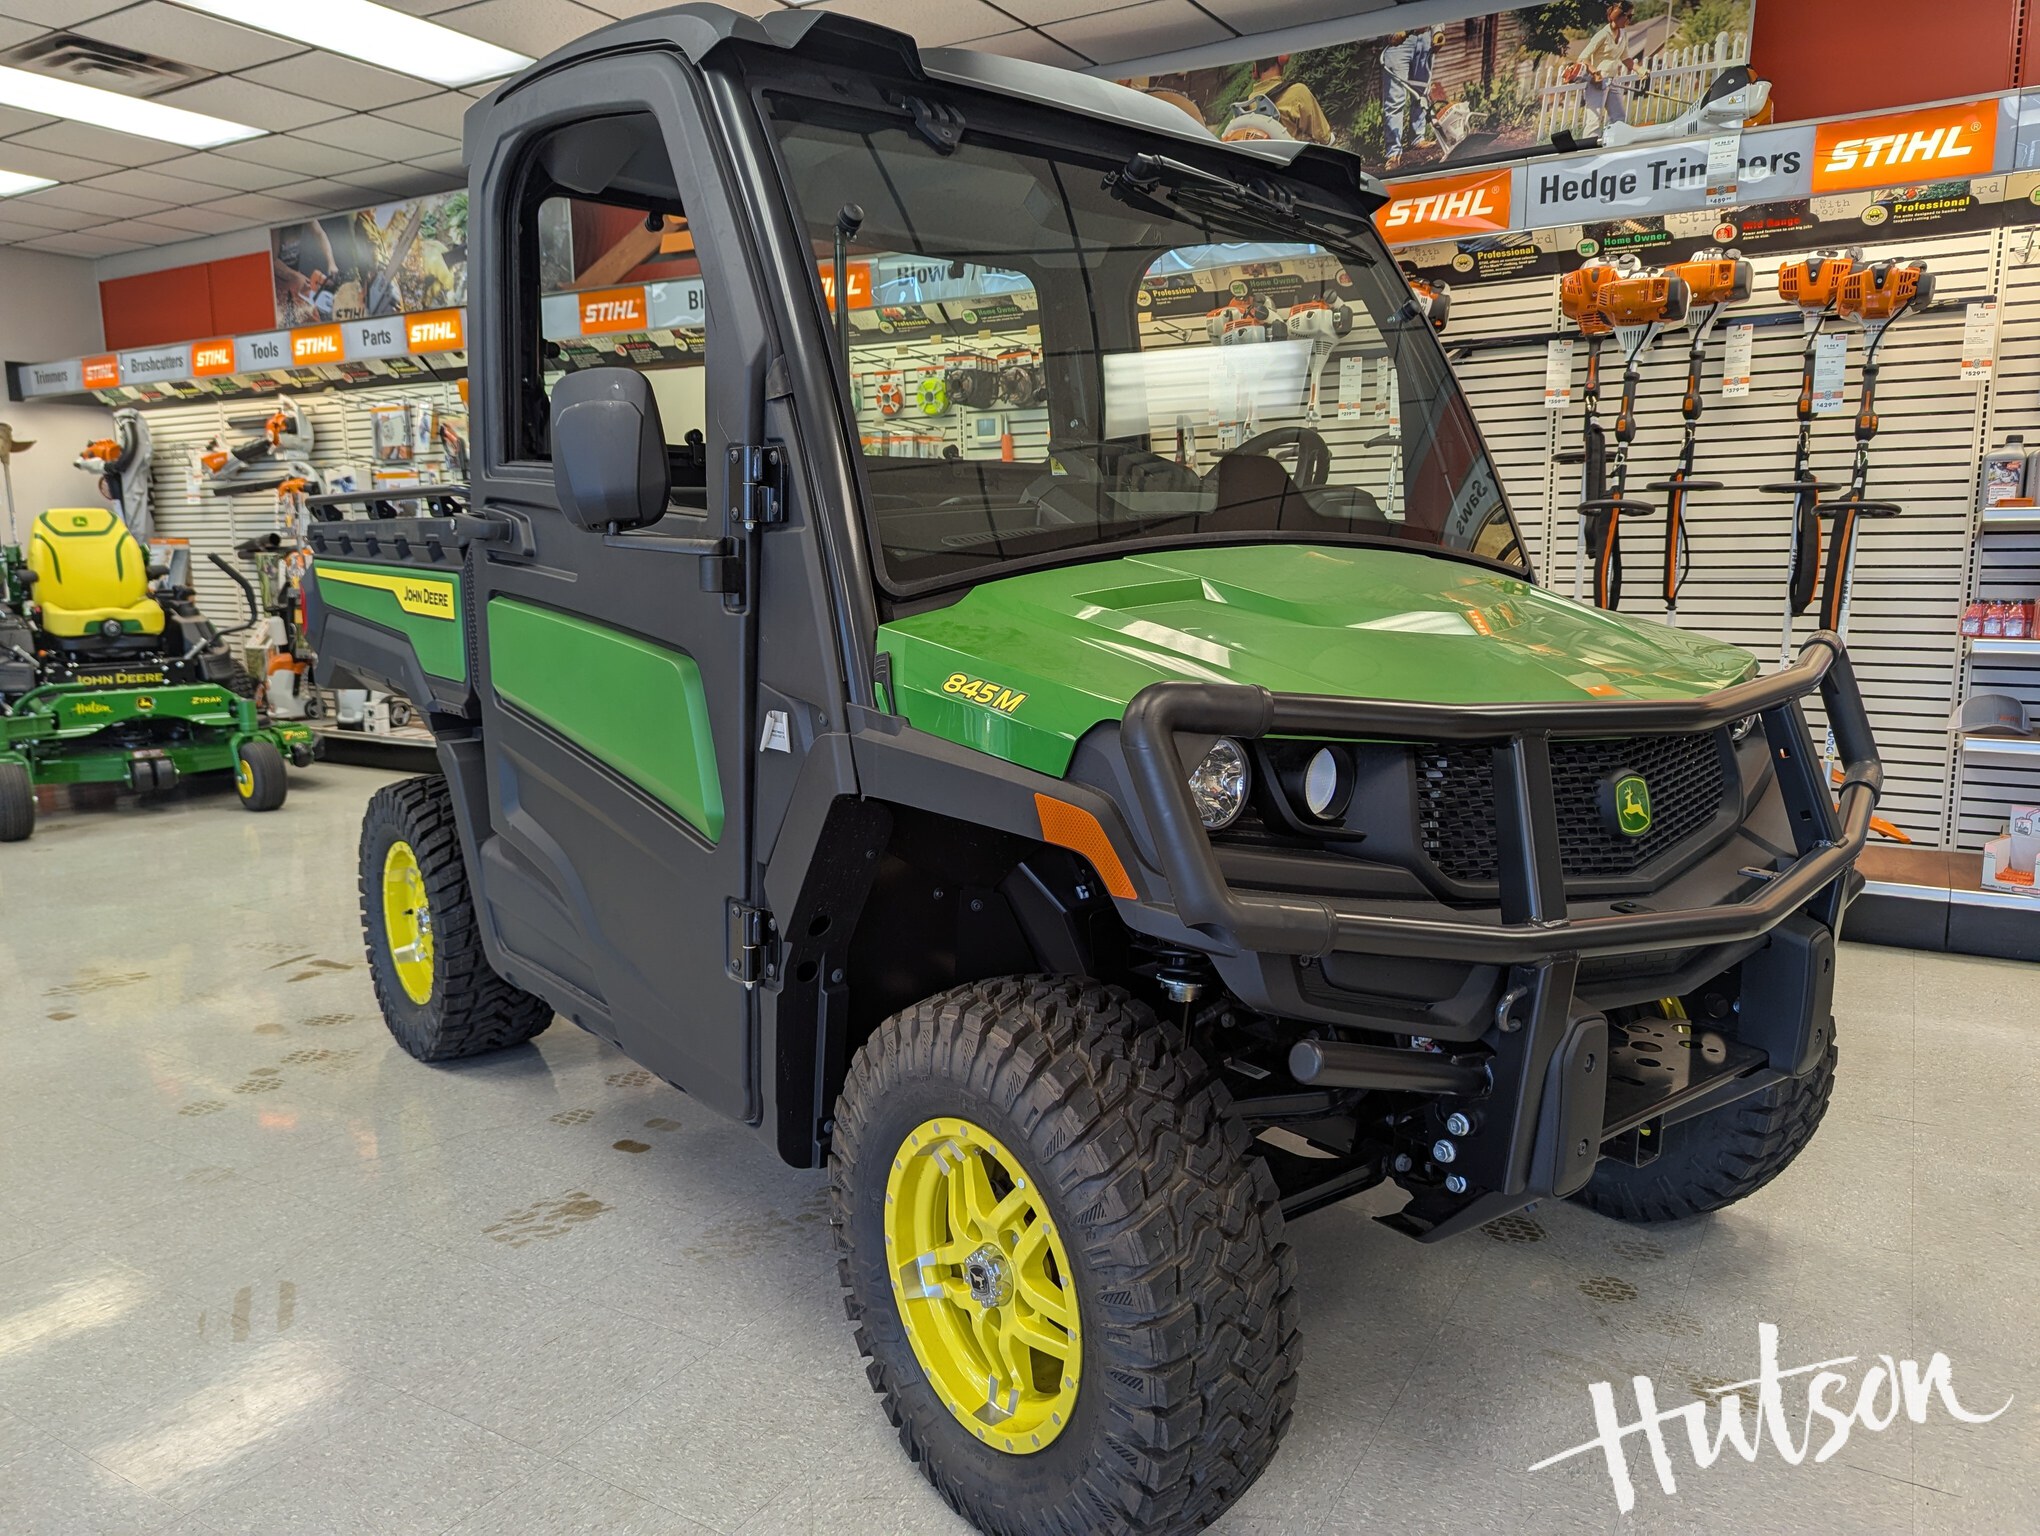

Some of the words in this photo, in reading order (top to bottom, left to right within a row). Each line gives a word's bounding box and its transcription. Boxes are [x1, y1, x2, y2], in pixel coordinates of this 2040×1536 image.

[1824, 126, 1973, 173] STIHL
[1539, 169, 1637, 205] Hedge
[1385, 188, 1494, 228] STIHL
[1894, 196, 1970, 213] Professional
[1604, 237, 1631, 246] Home
[1634, 233, 1667, 243] Owner
[1477, 245, 1535, 261] Professional
[1250, 278, 1272, 287] Home
[1273, 277, 1299, 285] Owner
[1153, 286, 1198, 297] Professional
[584, 299, 639, 324] STIHL
[410, 321, 457, 343] STIHL
[893, 318, 931, 328] Professional
[295, 335, 338, 357] STIHL
[362, 329, 392, 347] Parts
[196, 348, 231, 367] STIHL
[251, 342, 279, 359] Tools
[86, 363, 115, 381] STIHL
[131, 353, 184, 374] Brushcutters
[34, 370, 68, 385] Trimmers
[404, 586, 423, 604] JOHN
[423, 588, 449, 608] DEERE
[77, 674, 114, 686] JOHN
[115, 672, 165, 685] DEERE
[943, 672, 1028, 714] 845M
